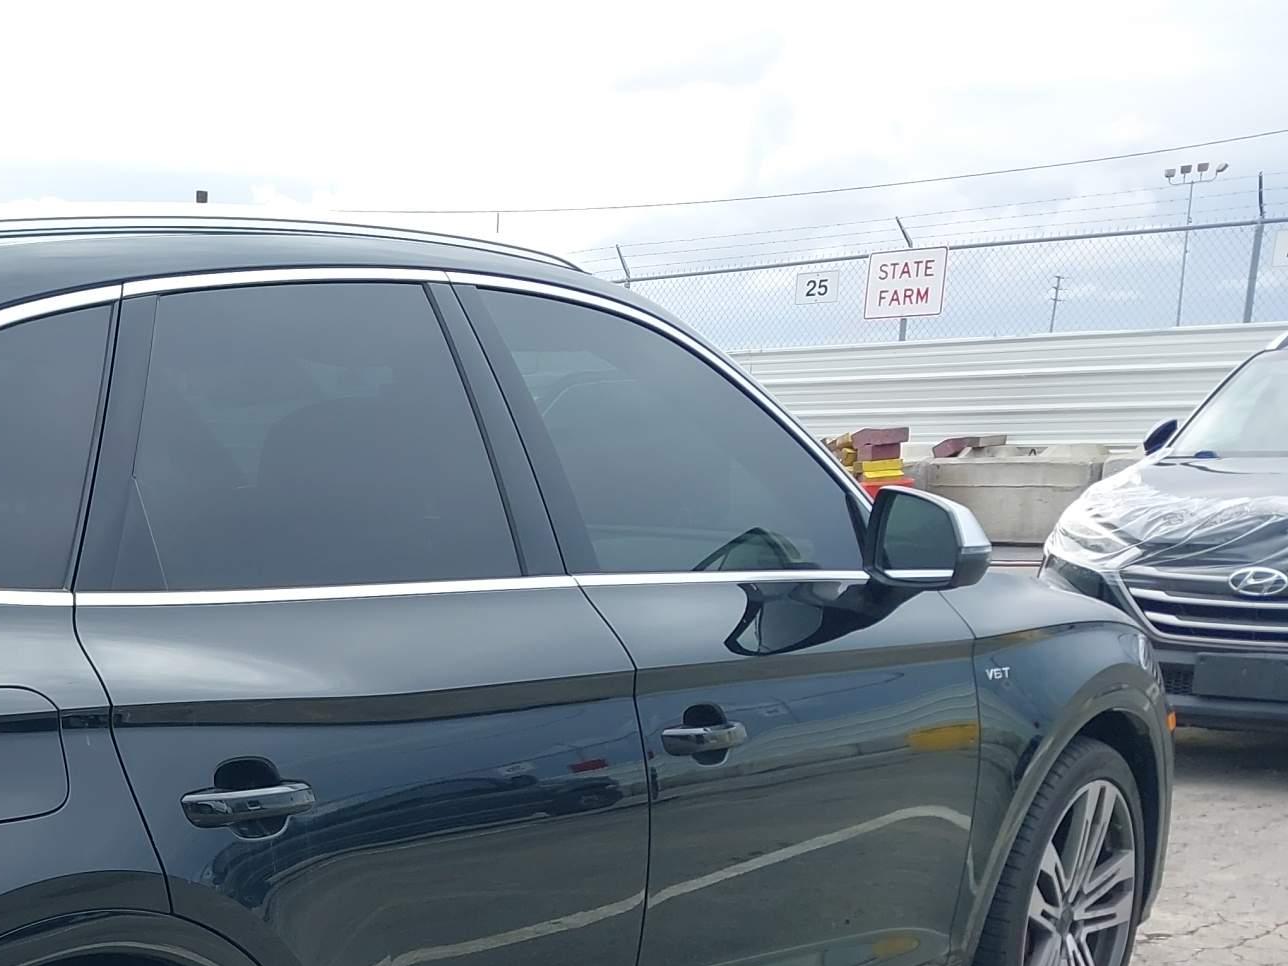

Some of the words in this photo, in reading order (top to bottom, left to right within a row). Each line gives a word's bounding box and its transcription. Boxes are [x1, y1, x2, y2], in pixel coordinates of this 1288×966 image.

[878, 259, 935, 280] STATE
[805, 279, 828, 297] 25
[878, 287, 929, 306] FARM
[985, 667, 1010, 680] V6T
